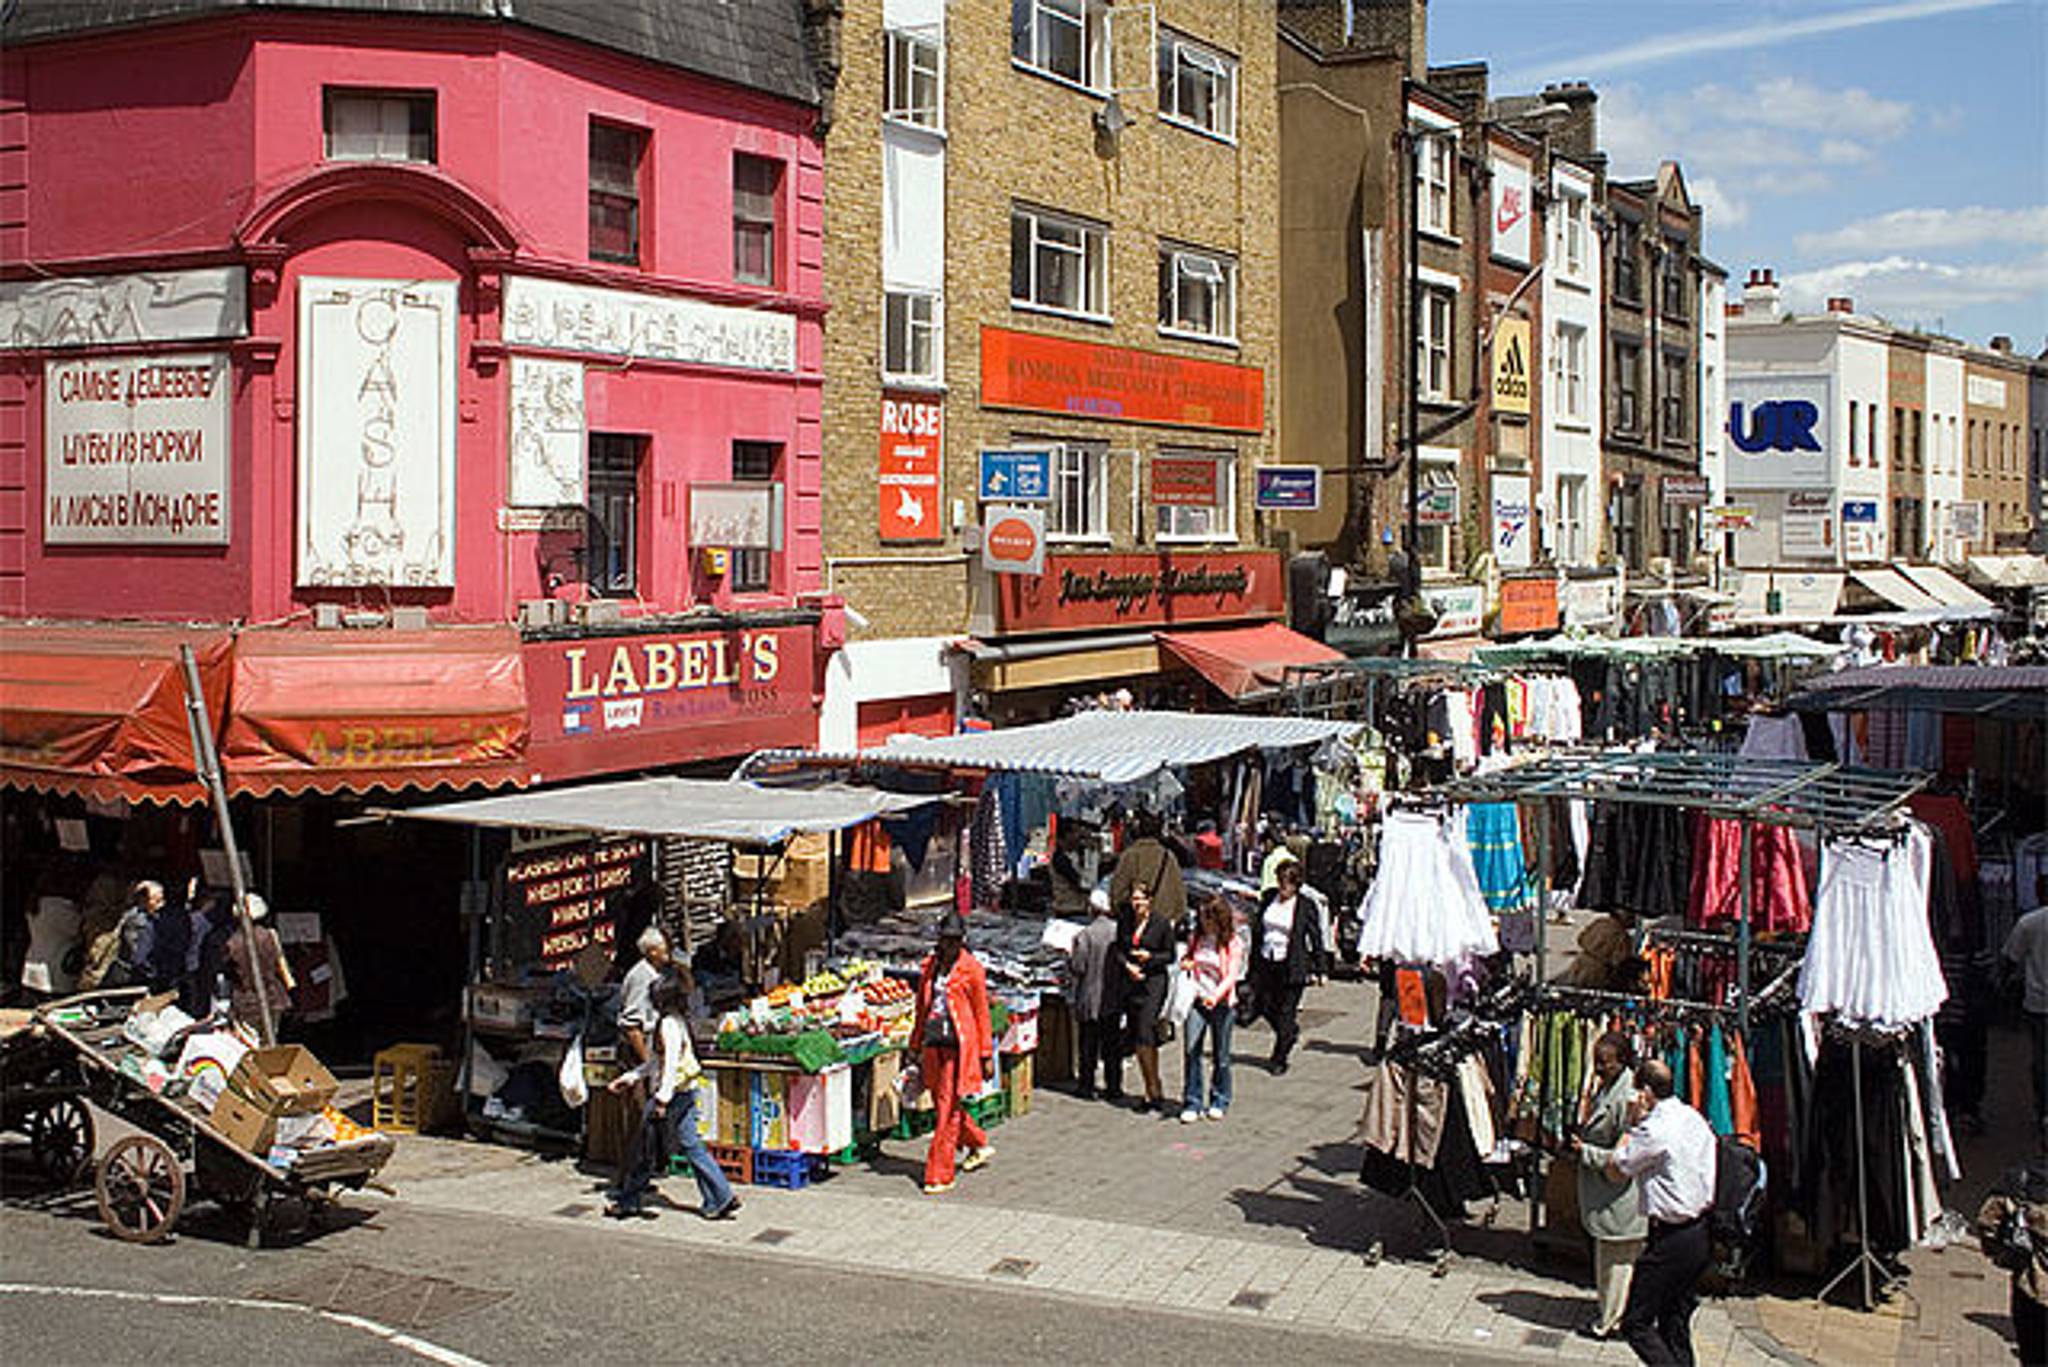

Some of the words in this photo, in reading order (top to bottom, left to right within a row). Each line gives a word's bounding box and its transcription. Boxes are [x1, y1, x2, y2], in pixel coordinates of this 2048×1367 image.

[60, 370, 120, 403] САМЫЕ
[125, 365, 212, 408] ДЕШЕВЫЕ
[882, 400, 940, 436] ROSE
[63, 431, 112, 465] ШУБЫ
[116, 431, 137, 464] ИЗ
[140, 429, 203, 463] НОРКИ
[50, 495, 62, 527] И
[66, 493, 115, 527] ЛИСЫ
[118, 495, 129, 526] В
[132, 491, 219, 534] ЛОНДОНЕ
[565, 634, 780, 701] LABEL'S
